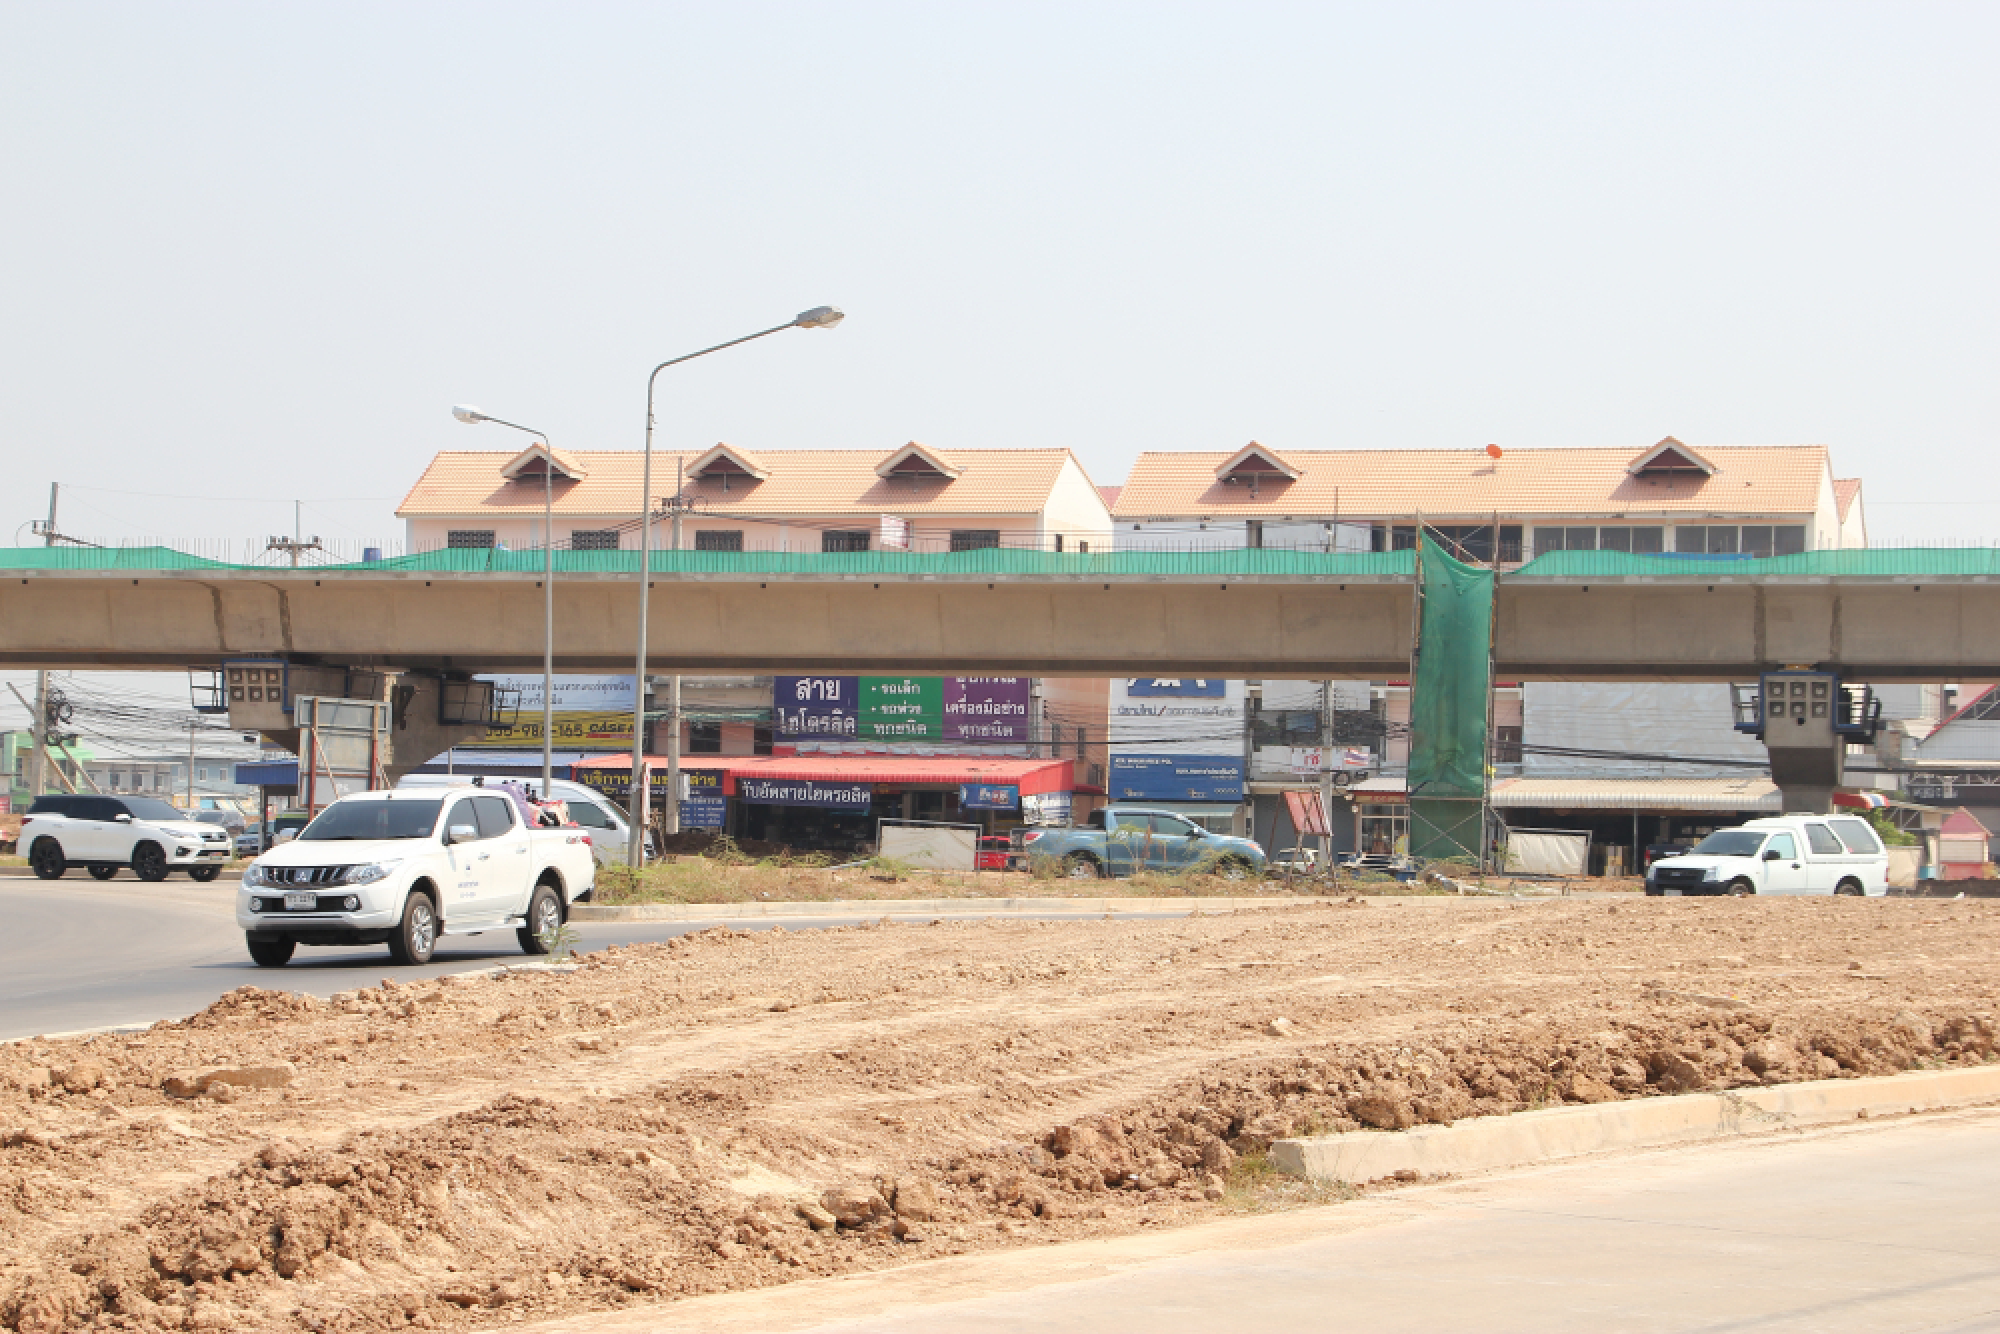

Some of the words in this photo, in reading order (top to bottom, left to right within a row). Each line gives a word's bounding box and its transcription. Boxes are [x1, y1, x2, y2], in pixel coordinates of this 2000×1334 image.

[795, 677, 841, 701] สาย
[881, 679, 921, 695] รถเล็ก
[880, 699, 923, 715] รถพ่วง
[873, 717, 927, 740] ทุกชนิด
[957, 718, 1014, 739] ทุกชนิด
